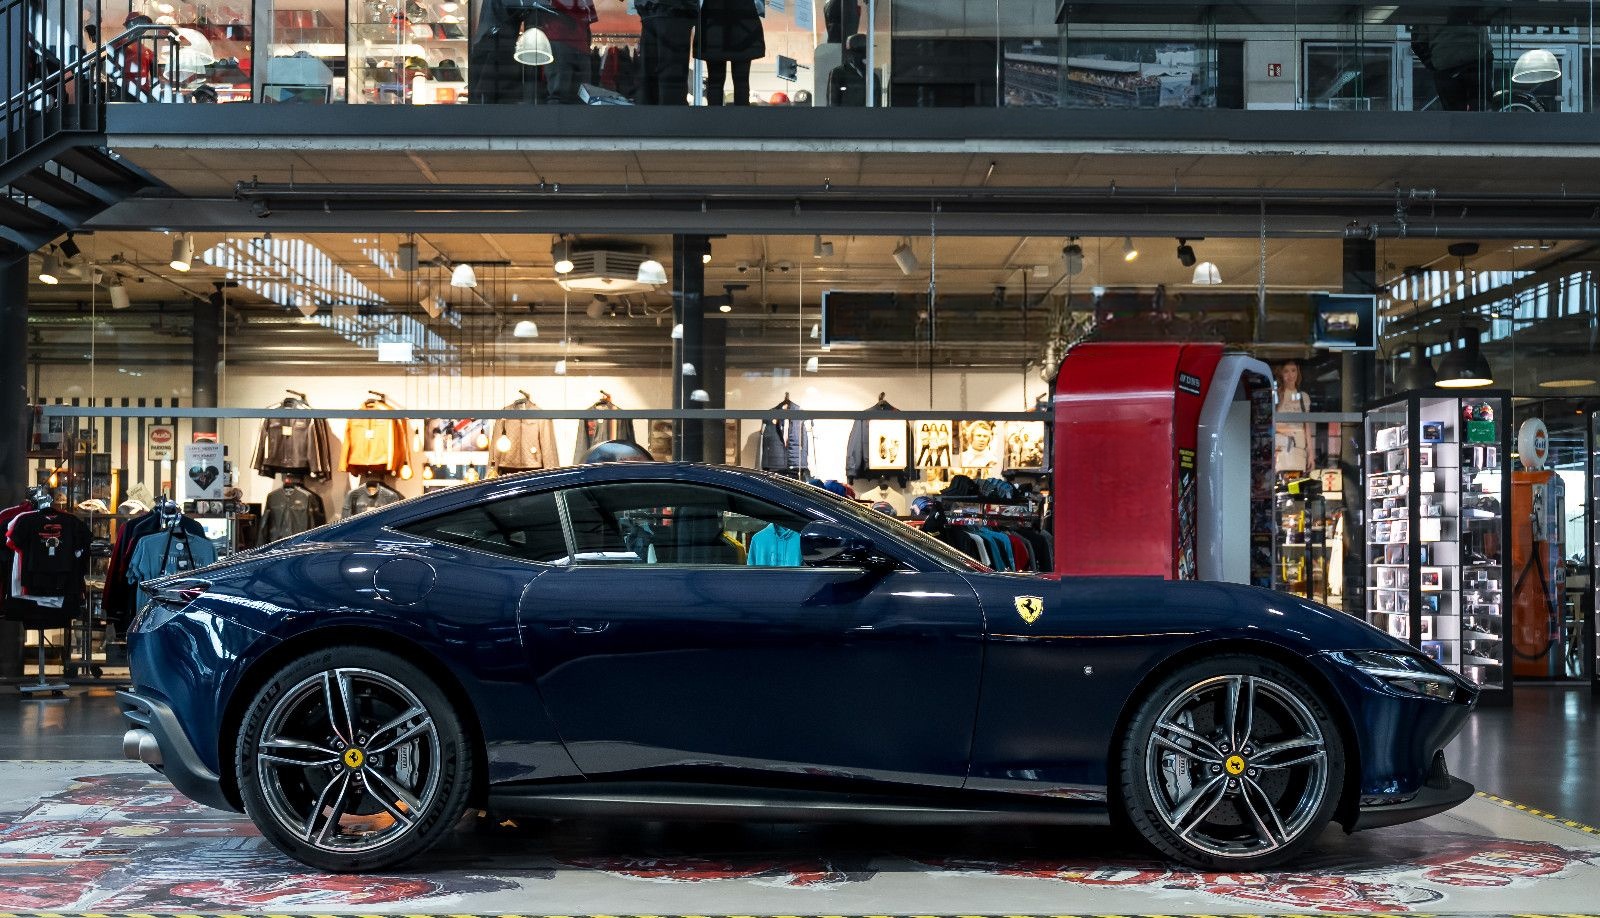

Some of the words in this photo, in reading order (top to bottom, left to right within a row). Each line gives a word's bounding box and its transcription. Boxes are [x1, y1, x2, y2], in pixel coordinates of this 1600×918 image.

[242, 682, 281, 758] MICHELIN
[418, 761, 457, 837] MICHELIN
[1145, 810, 1214, 865] MICHELIN
